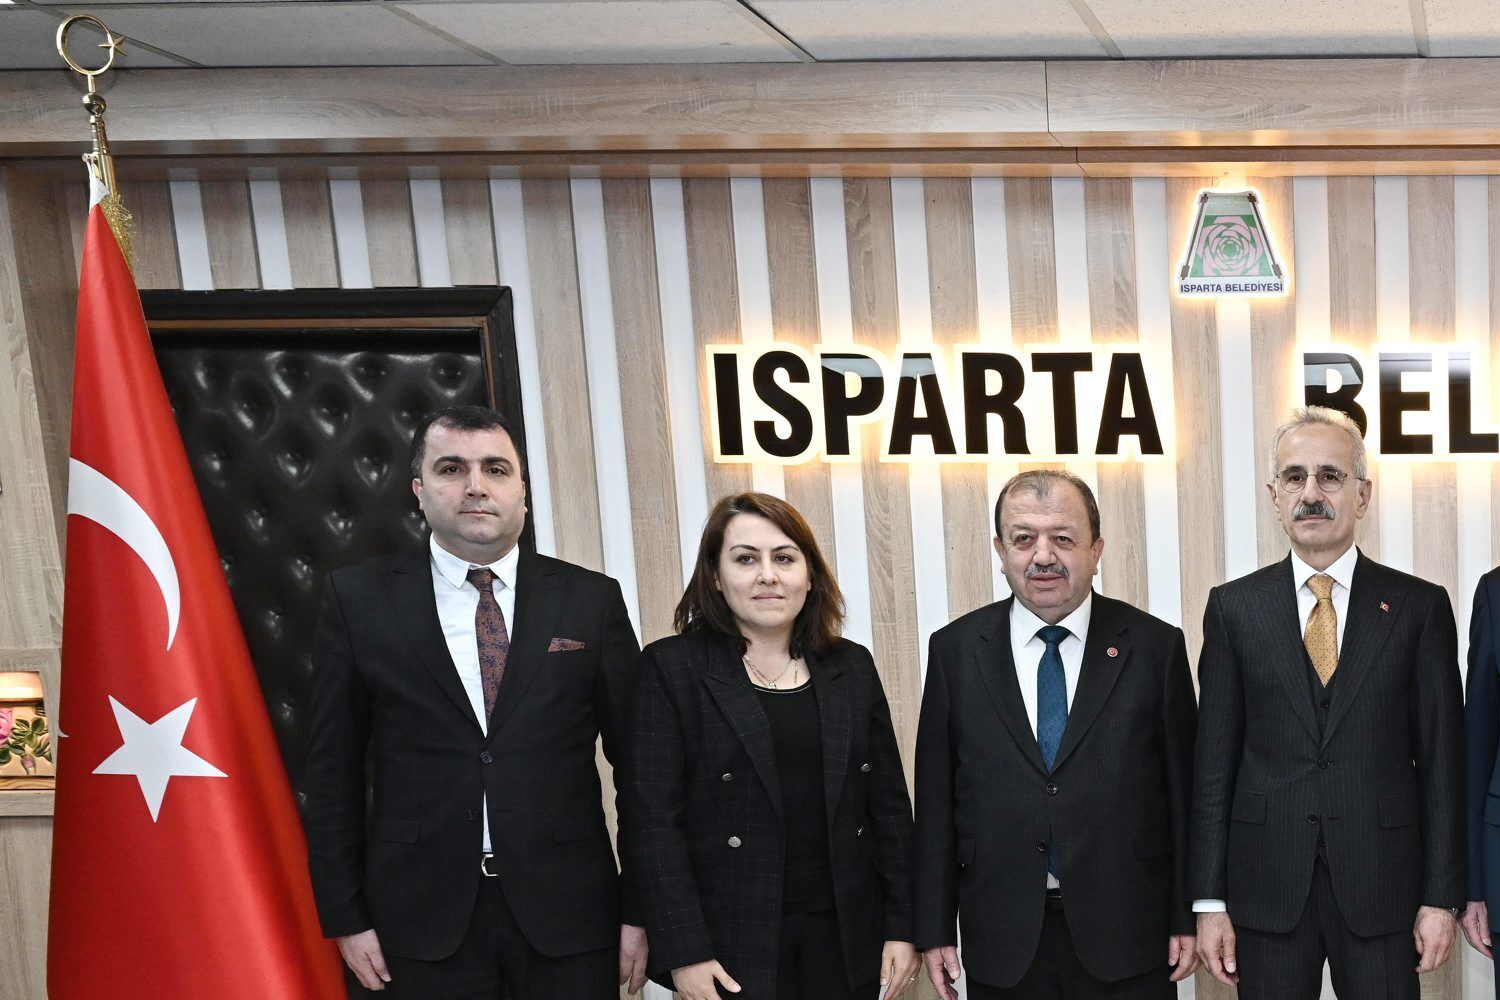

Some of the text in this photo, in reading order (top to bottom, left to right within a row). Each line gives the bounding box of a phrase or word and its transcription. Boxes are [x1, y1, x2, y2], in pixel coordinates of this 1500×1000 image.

[1180, 281, 1283, 293] ISPARTA BELEDİYESİ
[713, 350, 1165, 458] ISPARTA
